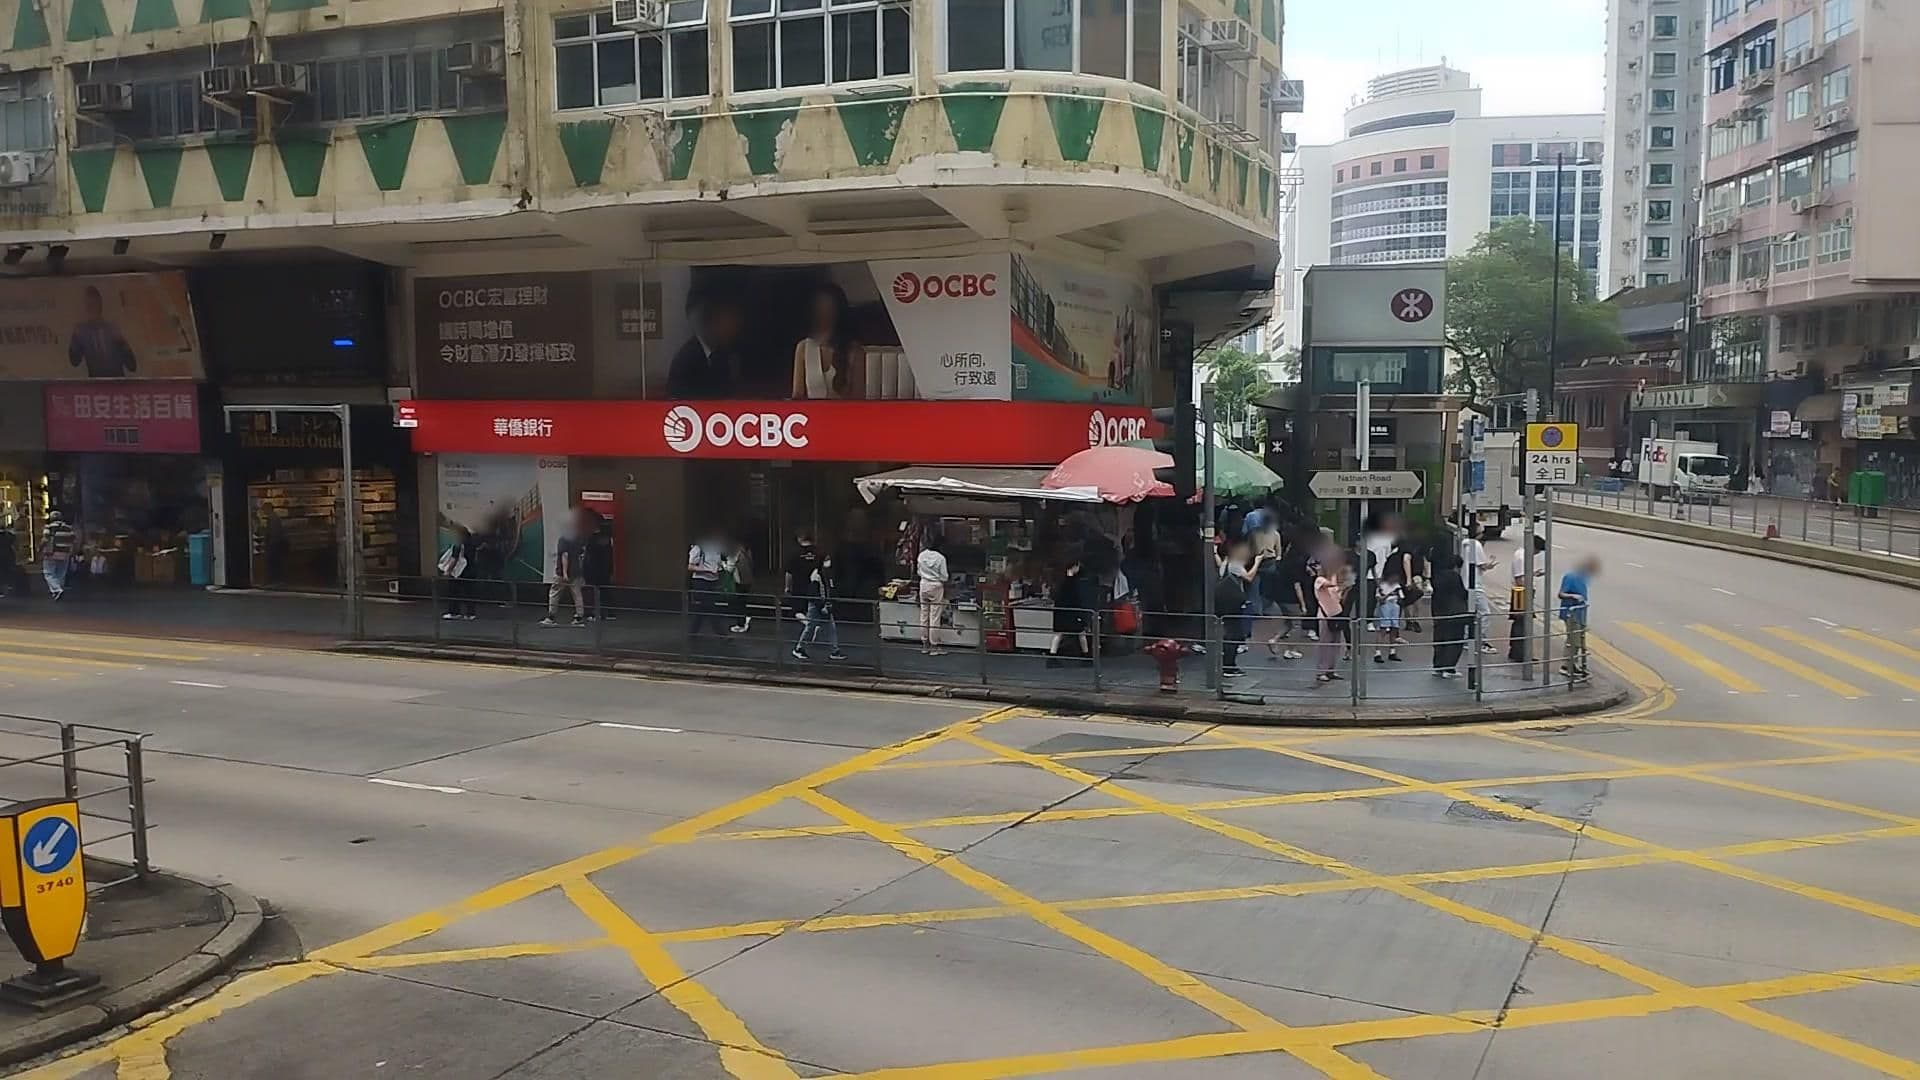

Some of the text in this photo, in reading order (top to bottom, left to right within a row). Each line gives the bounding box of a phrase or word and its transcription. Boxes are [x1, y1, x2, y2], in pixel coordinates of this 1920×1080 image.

[923, 274, 996, 298] OCBC
[954, 371, 997, 385] 行致遠
[492, 418, 553, 437] 華僑銀行
[705, 412, 809, 448] OCBC
[1106, 417, 1146, 446] OCBC
[1532, 454, 1571, 464] 24 hrs
[1337, 474, 1392, 482] Nathan Road
[1535, 467, 1566, 481] 全日
[37, 877, 74, 894] 3740
